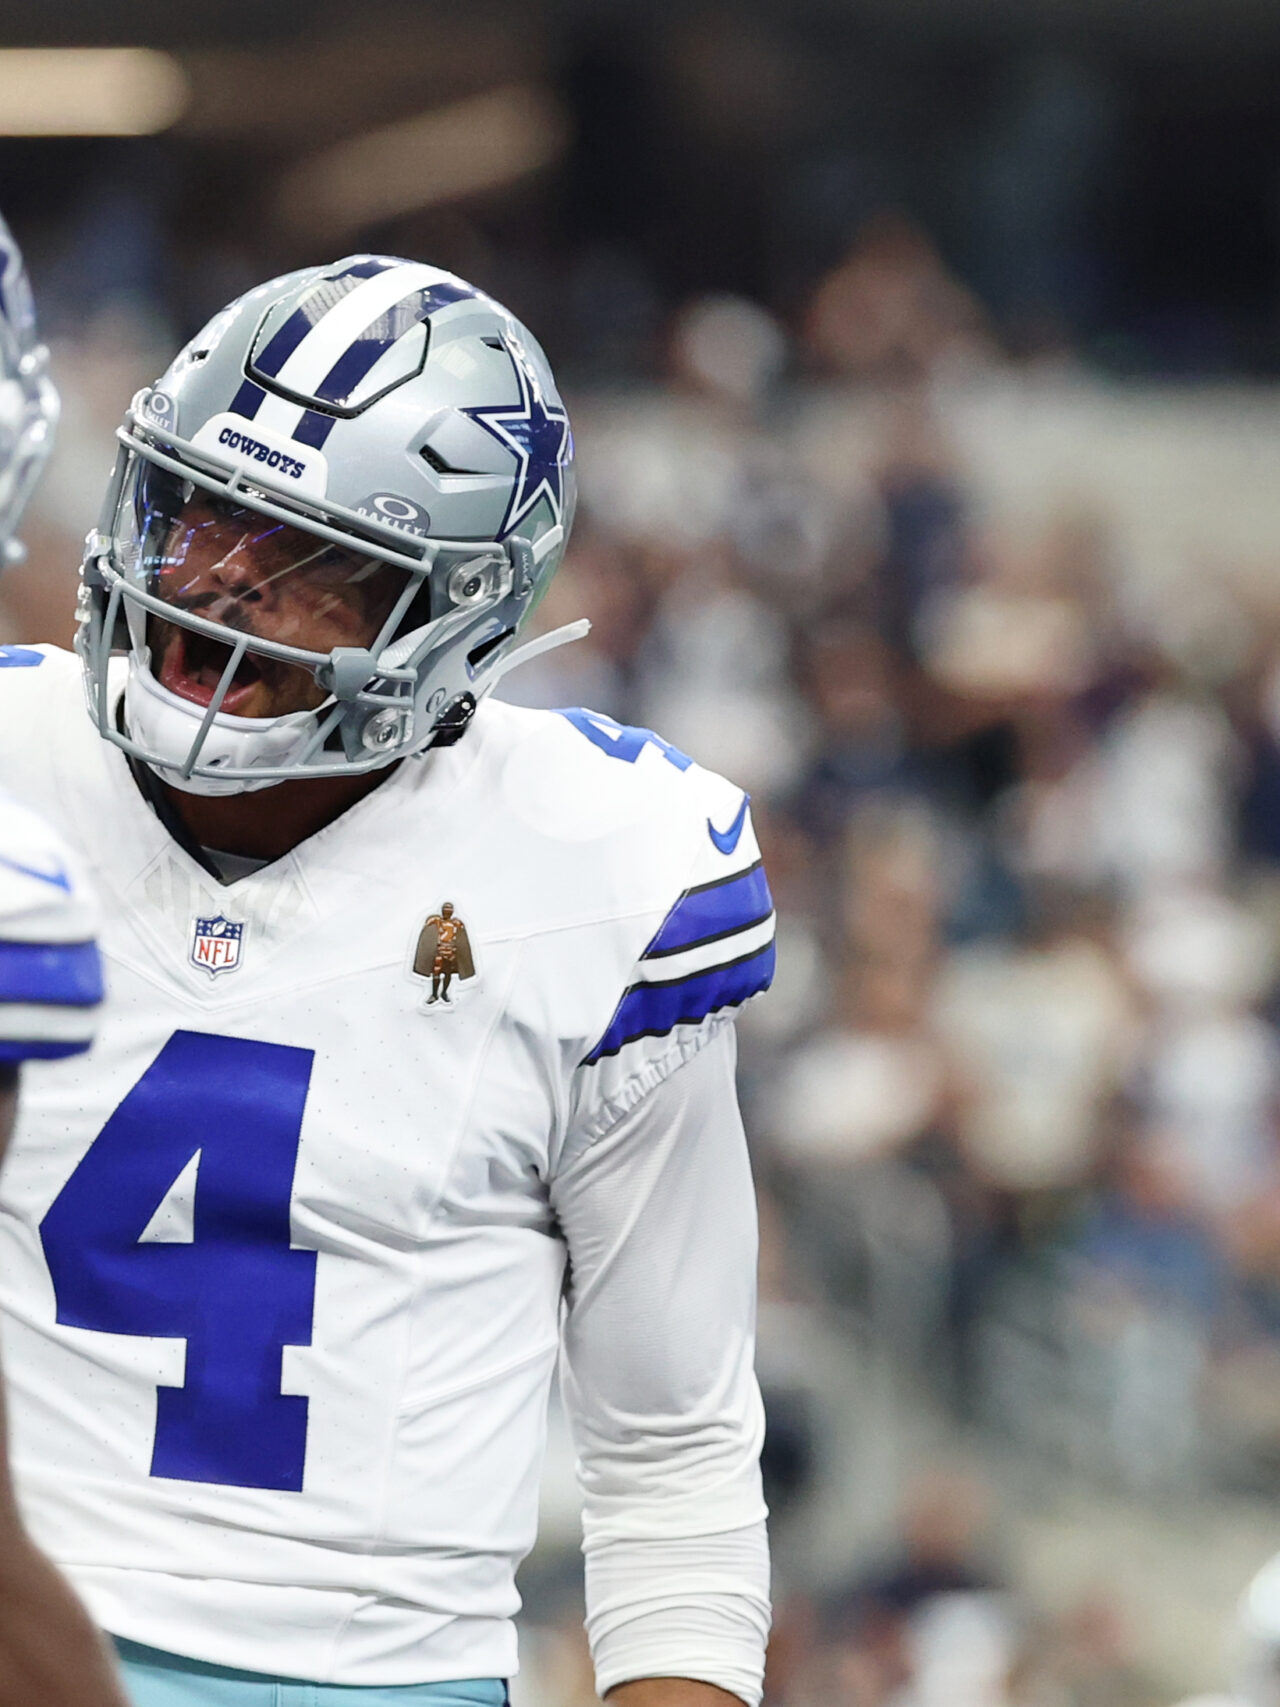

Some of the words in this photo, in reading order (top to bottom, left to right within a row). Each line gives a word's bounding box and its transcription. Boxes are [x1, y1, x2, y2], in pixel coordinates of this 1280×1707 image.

[218, 427, 306, 479] COWBOYS
[198, 937, 234, 964] NFL
[39, 1029, 317, 1493] 4
